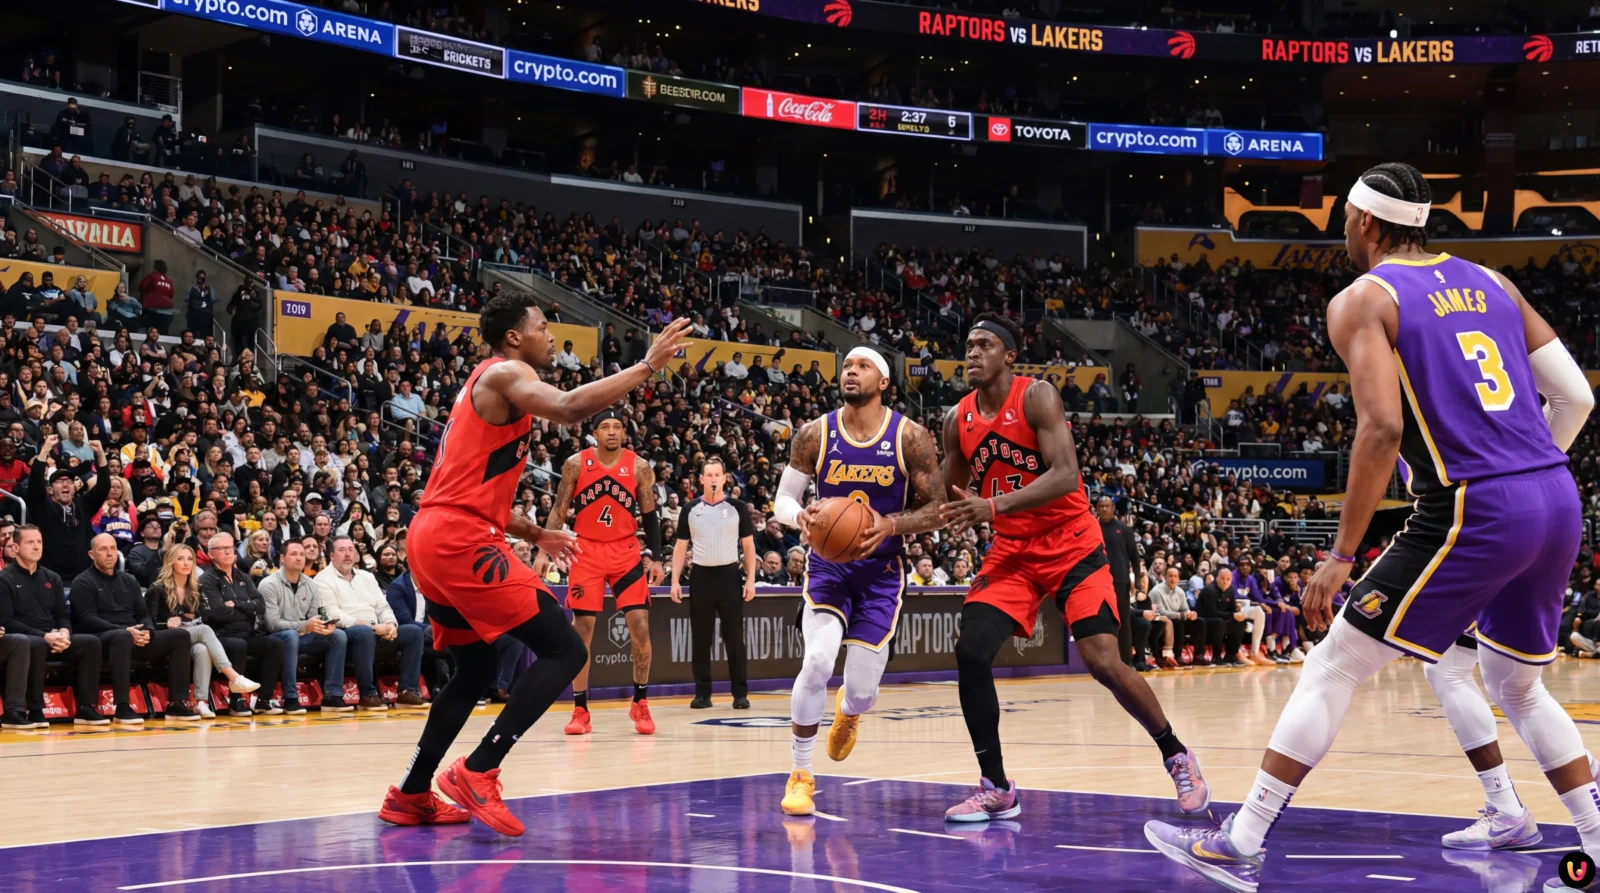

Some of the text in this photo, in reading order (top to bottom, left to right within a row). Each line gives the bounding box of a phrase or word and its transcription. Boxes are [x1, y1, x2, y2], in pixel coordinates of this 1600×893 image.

[322, 20, 382, 44] ARENA
[918, 11, 1005, 42] RAPTORS
[1031, 23, 1104, 51] LAKERS
[1262, 39, 1349, 63] RAPTORS
[1377, 40, 1454, 63] LAKERS
[514, 60, 617, 89] crypto.com
[901, 111, 927, 124] 2:37
[1015, 125, 1071, 141] TOYOTA
[1096, 131, 1197, 148] crypto.com
[1248, 139, 1304, 153] ARENA
[1427, 288, 1487, 318] JAMES
[1455, 330, 1516, 412] 3
[824, 459, 895, 487] LAKERS
[580, 480, 632, 508] RAPTORS
[596, 505, 613, 527] 4
[893, 613, 962, 655] APTORS
